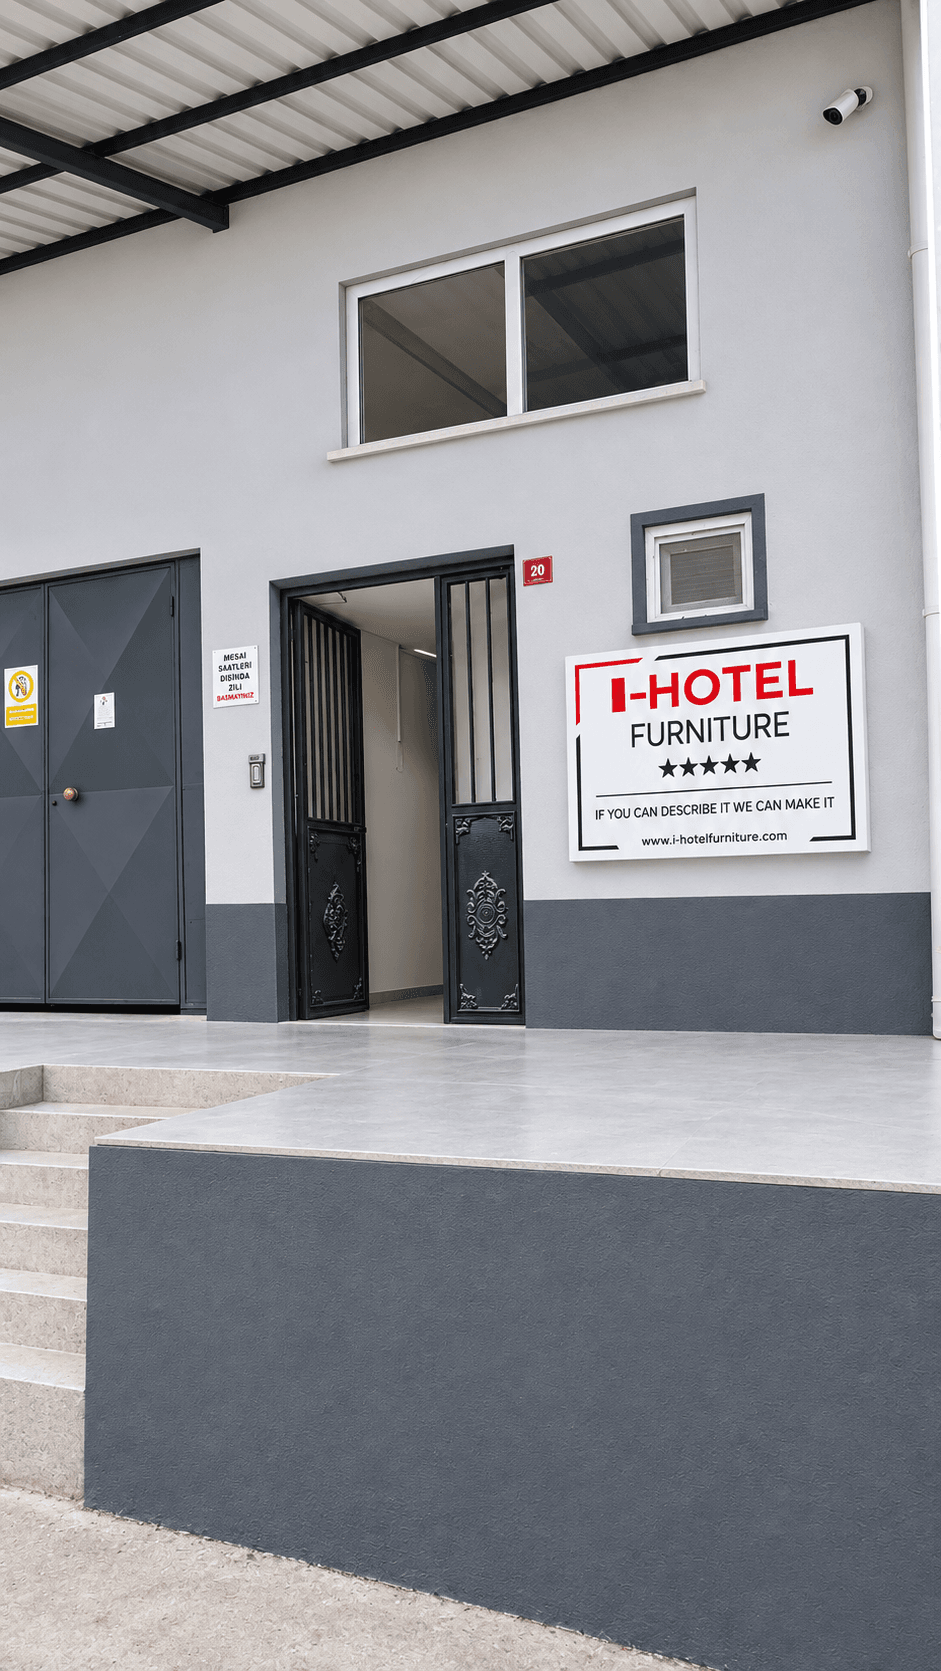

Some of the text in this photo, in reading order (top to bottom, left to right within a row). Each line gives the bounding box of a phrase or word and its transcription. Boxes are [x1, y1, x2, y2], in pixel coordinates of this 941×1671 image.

[530, 564, 545, 577] 20
[611, 659, 814, 713] I-HOTEL
[631, 710, 790, 748] FURNITURE
[595, 796, 835, 820] IF YOU CAN DESCRIBE IT WE CAN MAKE IT
[641, 831, 788, 847] www.i-hotelfurniture.com
